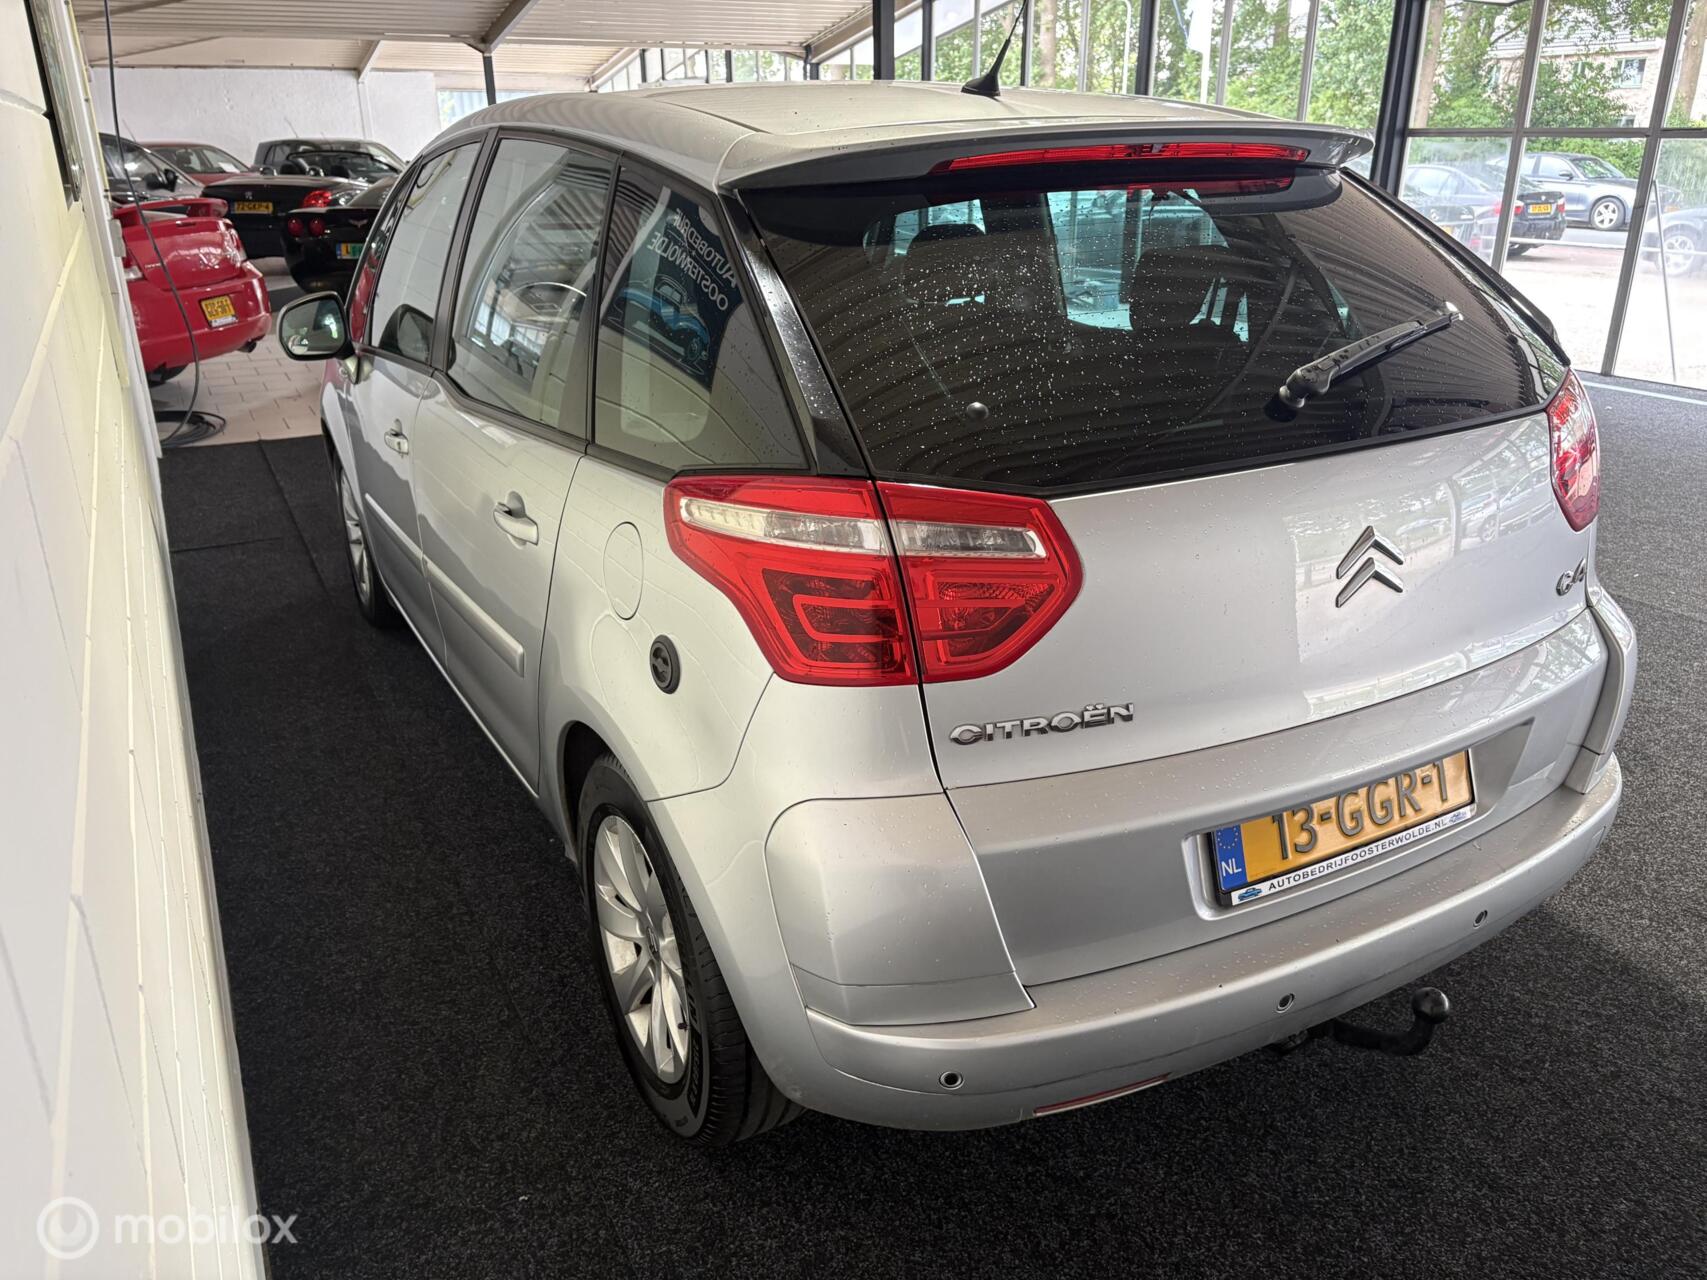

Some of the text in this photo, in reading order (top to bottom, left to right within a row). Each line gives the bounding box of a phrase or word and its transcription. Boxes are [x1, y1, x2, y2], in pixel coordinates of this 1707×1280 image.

[1556, 557, 1585, 597] C4
[950, 702, 1134, 746] CITROËN
[1272, 759, 1448, 861] 13-GGR-1
[1221, 859, 1242, 877] NL
[1268, 819, 1447, 891] AUTOBEDRIJFOOSTERWOLDE.NL
